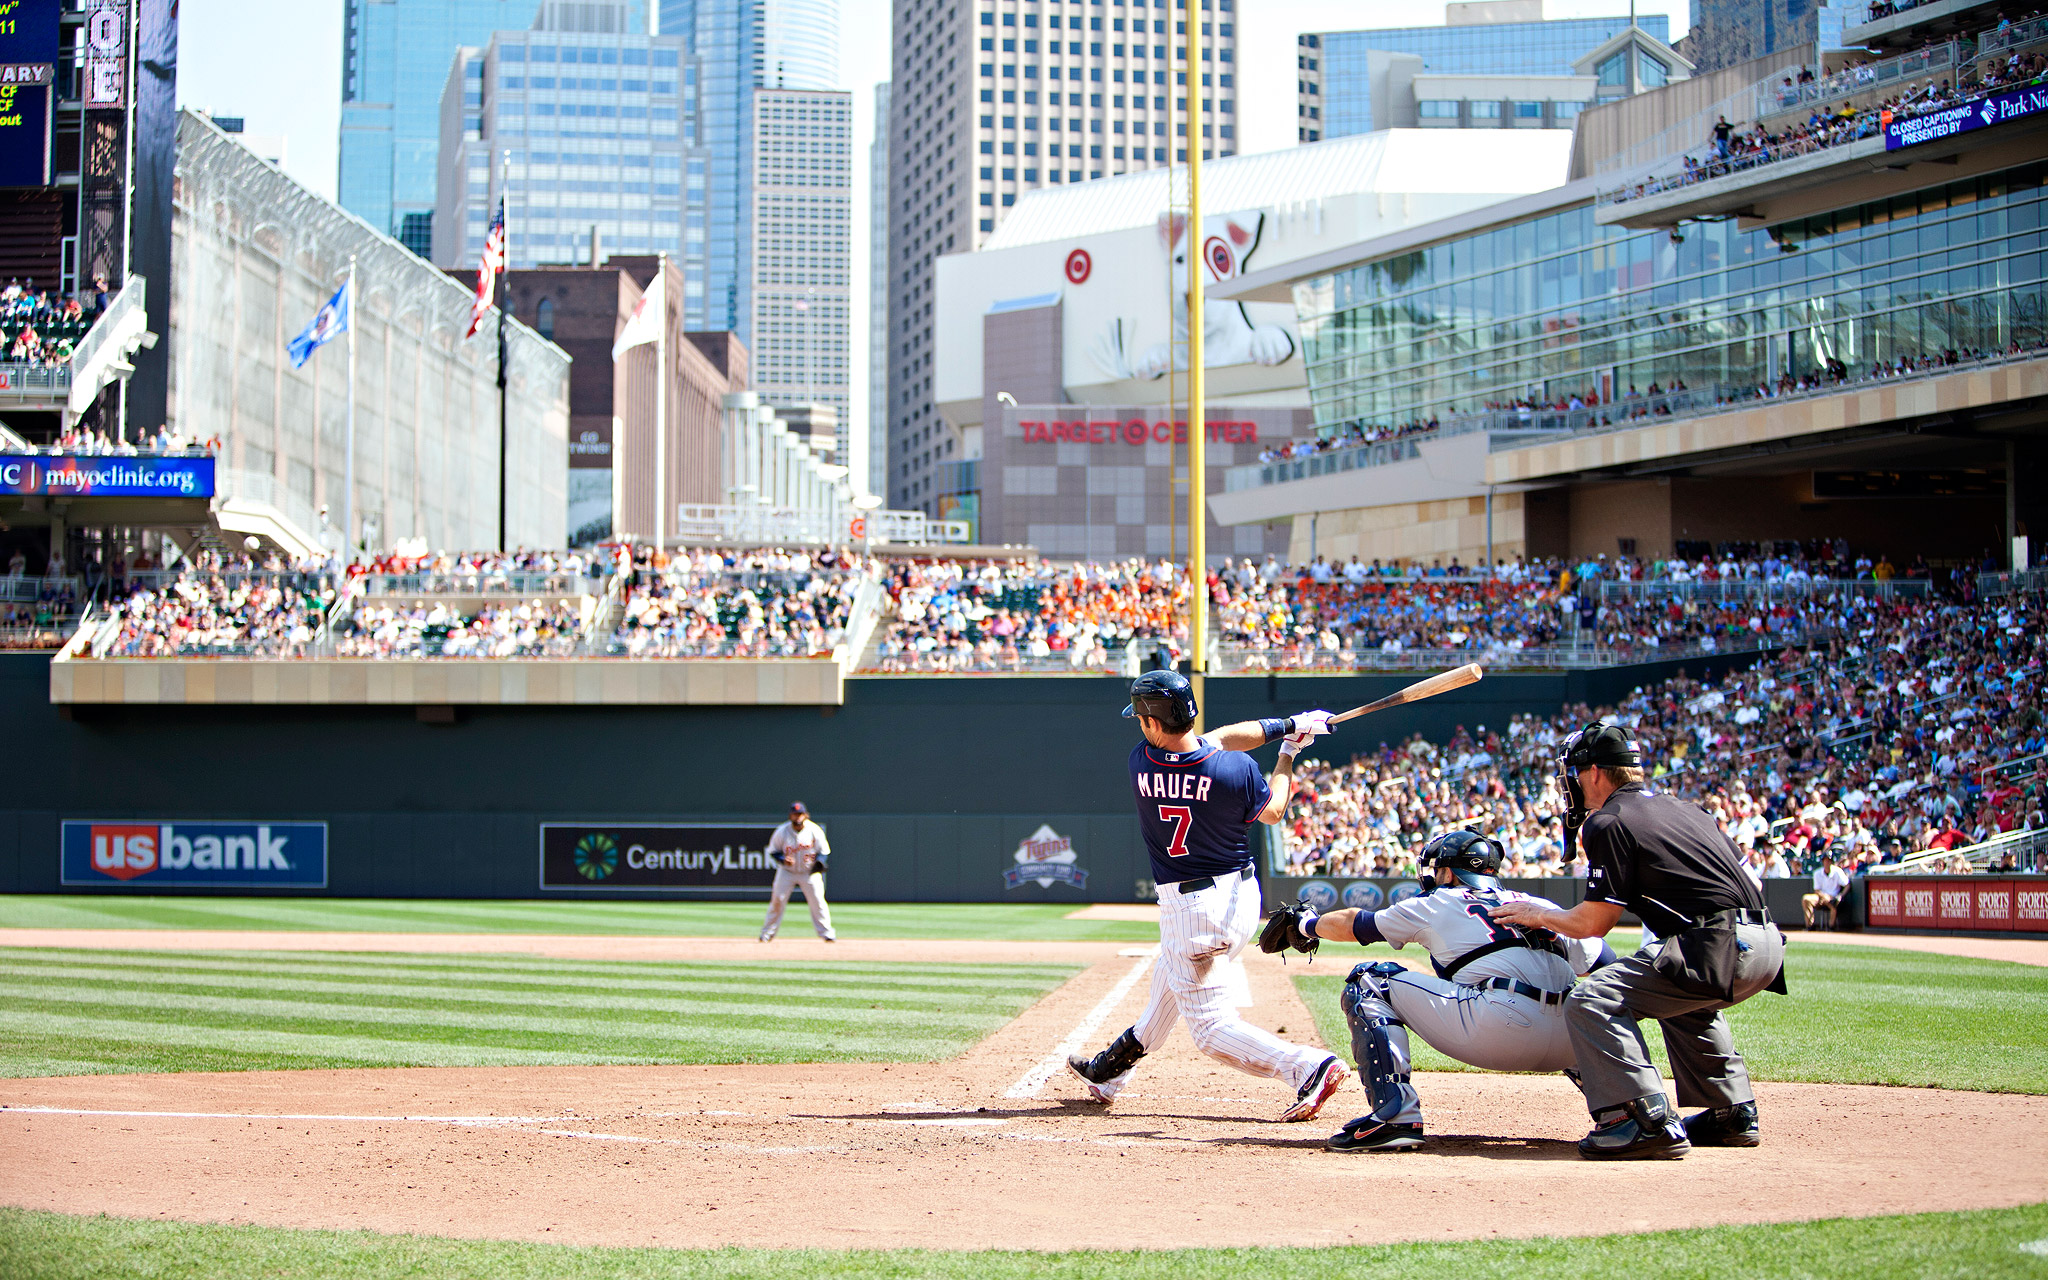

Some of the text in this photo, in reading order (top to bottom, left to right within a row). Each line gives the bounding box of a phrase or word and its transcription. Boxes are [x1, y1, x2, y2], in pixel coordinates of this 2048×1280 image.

[0, 66, 45, 82] ARY
[1, 85, 18, 98] CF
[0, 99, 14, 111] CF
[2000, 94, 2028, 119] Park
[0, 113, 22, 126] out
[1890, 105, 1972, 137] CLOSED CAPTIONING
[1901, 120, 1961, 145] PRESENTED BY
[1019, 421, 1258, 444] TARGET CETER
[45, 465, 195, 494] mayoclinic.org
[1137, 772, 1212, 802] MAUER
[1158, 804, 1193, 858] 7
[1020, 837, 1070, 861] Twins
[626, 844, 778, 875] CenturyLink
[1871, 889, 1898, 906] SPORTS
[1905, 890, 1933, 907] SPORTS
[1940, 891, 1971, 908] SPORTS
[1978, 892, 2009, 909] SPORTS
[2017, 892, 2048, 909] SPORTS
[1871, 906, 1898, 916] AUTHORITY
[1905, 907, 1933, 917] AUTHORITY
[1940, 908, 1970, 918] AUTHORITY
[1978, 909, 2009, 919] AUTHORITY
